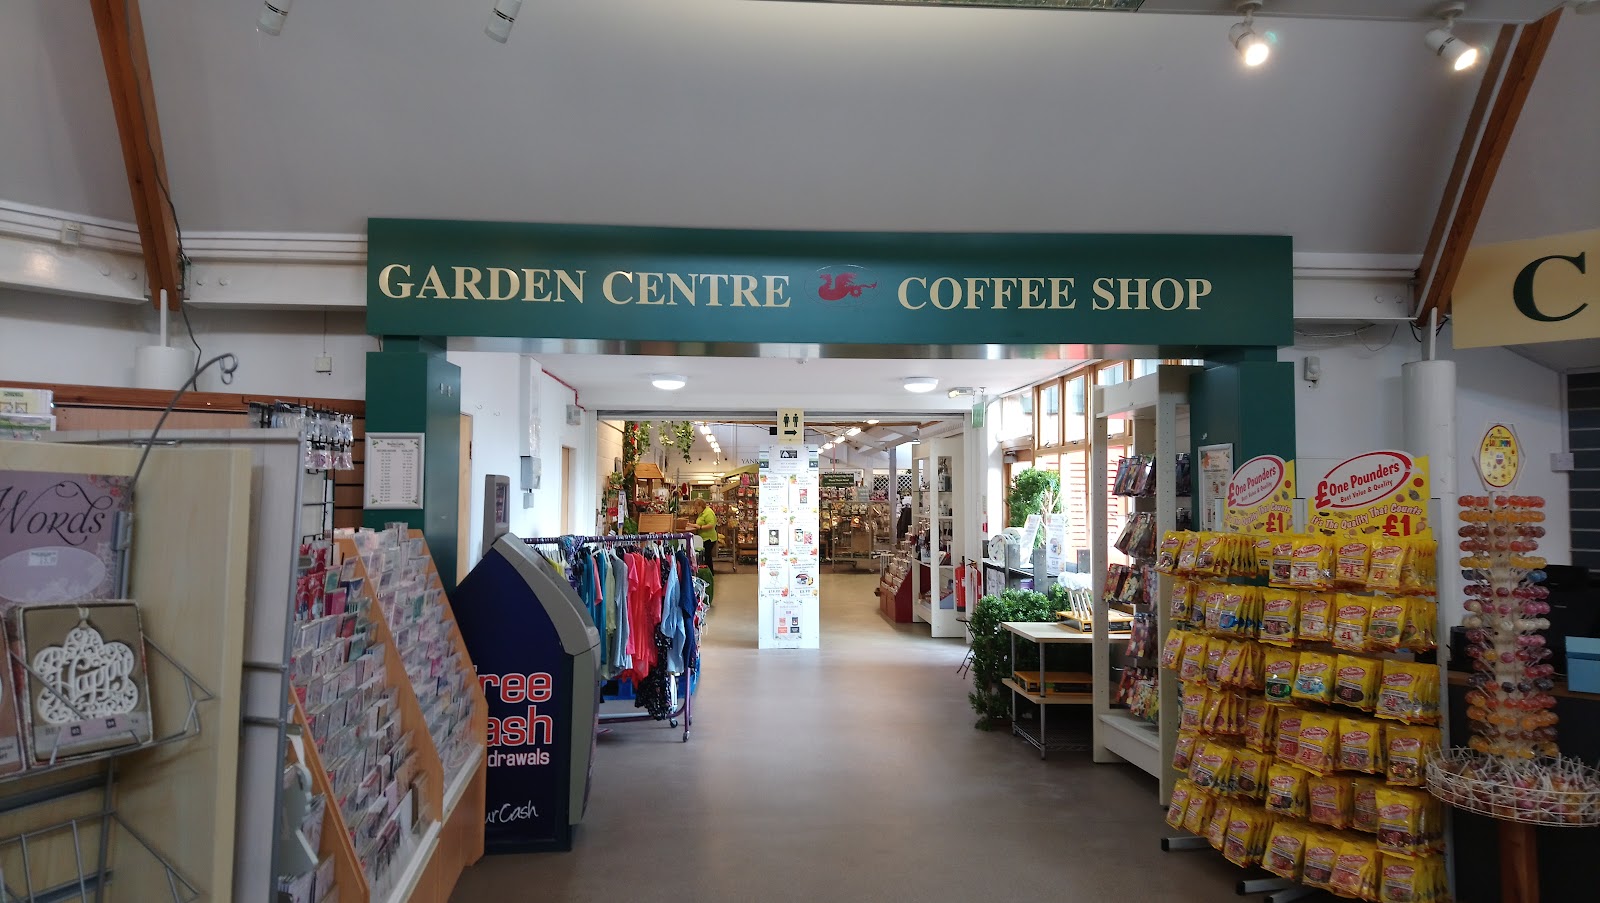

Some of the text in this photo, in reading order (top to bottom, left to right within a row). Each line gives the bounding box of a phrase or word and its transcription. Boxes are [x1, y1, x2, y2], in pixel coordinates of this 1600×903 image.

[378, 263, 791, 308] GARDEN CENTRE
[897, 276, 1213, 311] COFFEE SHOP
[1512, 251, 1589, 322] C
[1247, 466, 1277, 490] Pounders
[1350, 462, 1400, 488] Pounders
[1340, 494, 1352, 503] Best
[1352, 488, 1366, 499] Value
[1373, 480, 1394, 491] Quality
[1270, 502, 1291, 514] Counts
[1311, 503, 1423, 530] It's The Quality That Counts
[1265, 511, 1284, 534] £1
[1382, 514, 1411, 537] £1
[1373, 571, 1384, 579] £1
[1341, 631, 1352, 640] £1
[478, 672, 553, 703] ree
[487, 705, 553, 746] ash
[487, 748, 550, 767] drawals
[1302, 749, 1311, 760] £1
[485, 800, 539, 823] urCash
